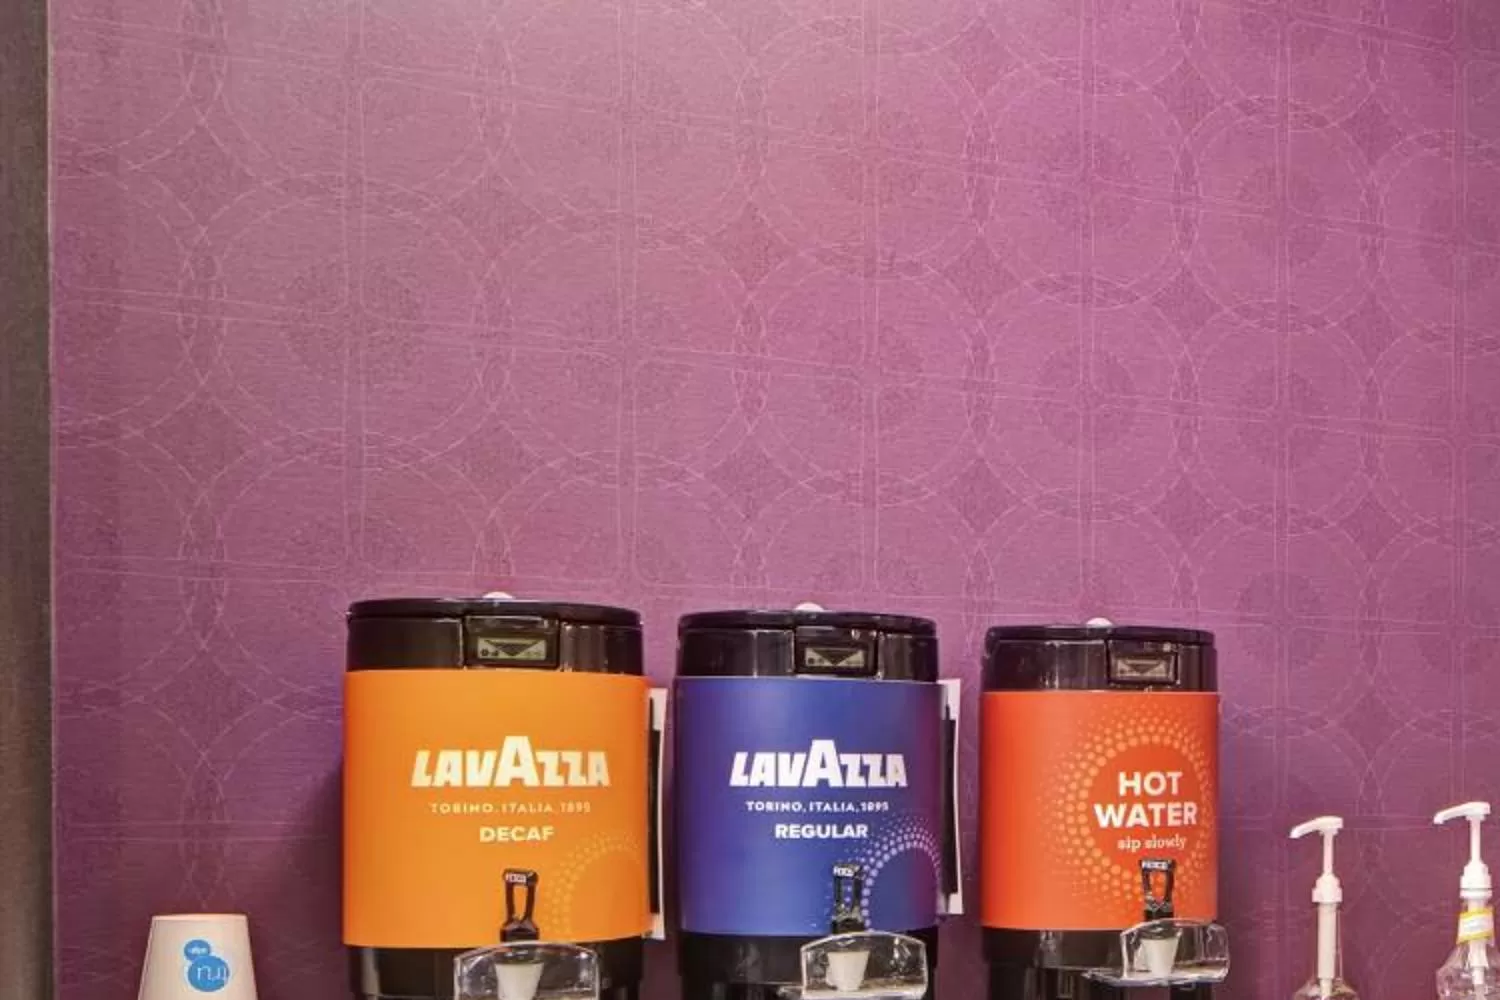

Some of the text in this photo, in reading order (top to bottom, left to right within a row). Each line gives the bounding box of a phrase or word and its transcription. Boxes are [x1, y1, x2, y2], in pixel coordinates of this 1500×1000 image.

[411, 736, 610, 787] LAVAZZA
[729, 739, 908, 787] LAVAZZA
[1118, 771, 1183, 796] HOT
[1093, 801, 1198, 828] WATER
[479, 825, 554, 843] DECAF
[775, 823, 868, 839] REGULAR
[1117, 833, 1187, 853] sip slowly
